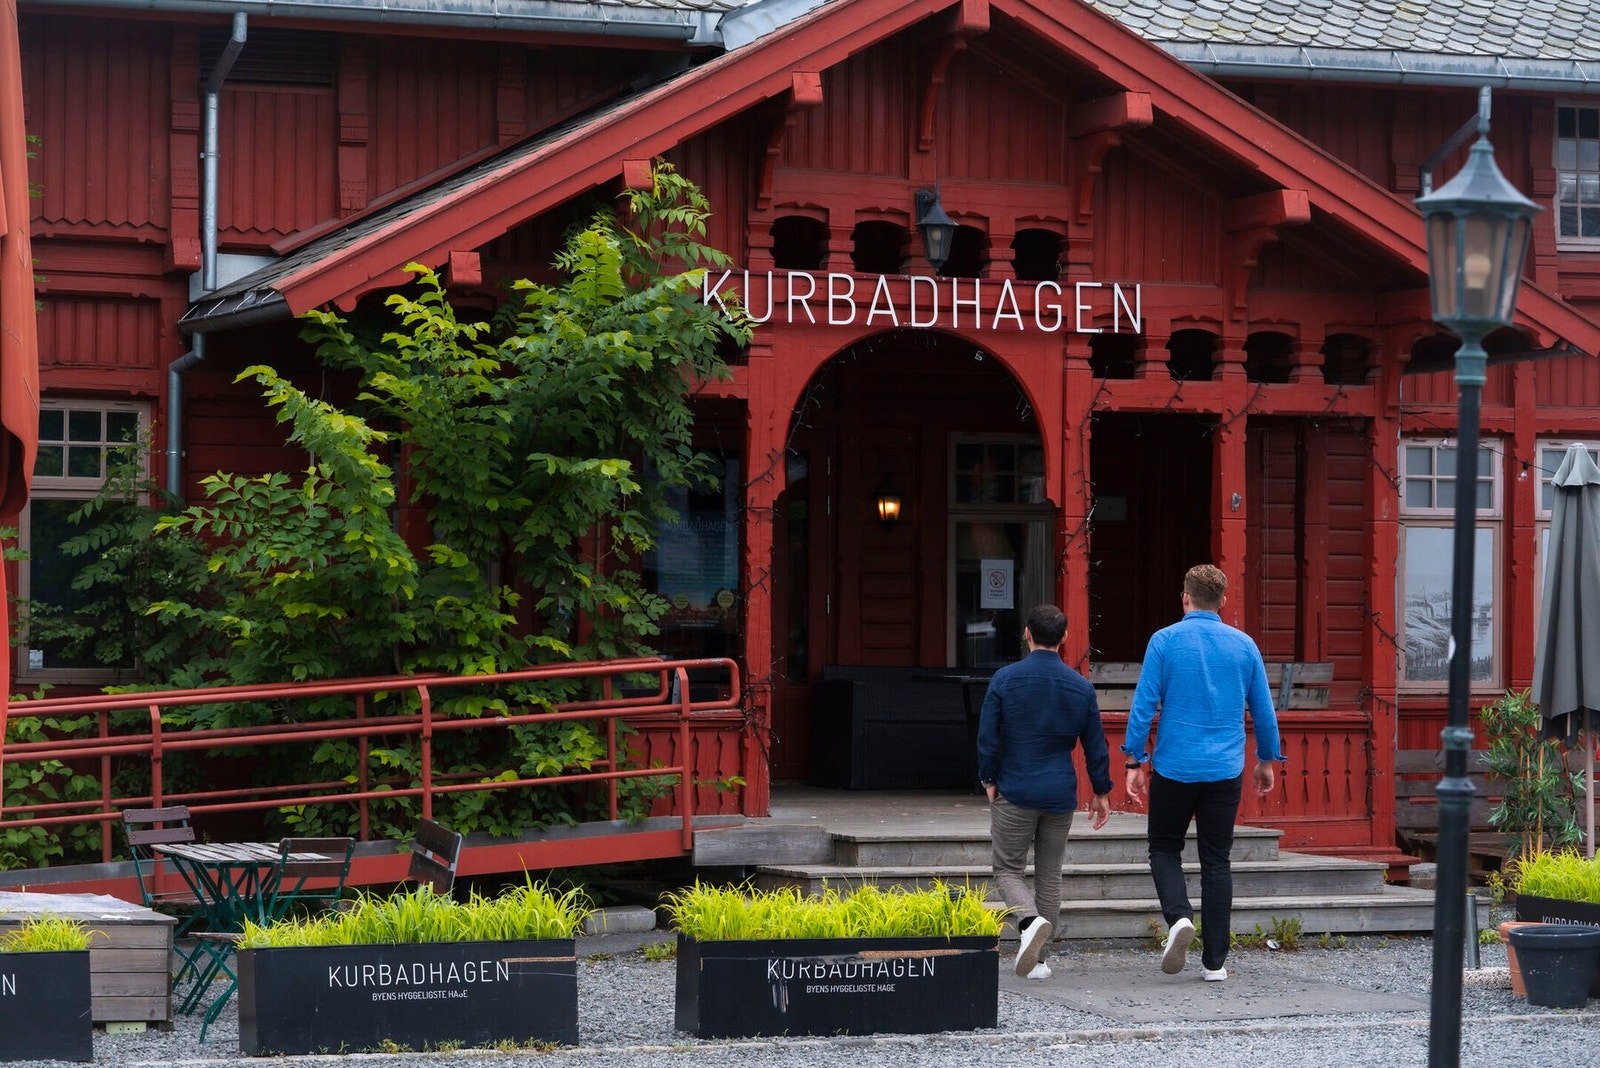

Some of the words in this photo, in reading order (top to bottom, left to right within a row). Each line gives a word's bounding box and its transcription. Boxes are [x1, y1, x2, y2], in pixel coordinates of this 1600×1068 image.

[703, 268, 1141, 334] KURBADHAGEN
[328, 960, 510, 988] KURBADHAGEN
[767, 956, 936, 980] KURBADHAGEN
[371, 992, 397, 1001] BYENS
[398, 990, 447, 1000] HYGGELIGSTE
[806, 984, 830, 993] BYENS
[830, 984, 877, 993] HYGGELIGSTE
[877, 983, 896, 992] HAGE
